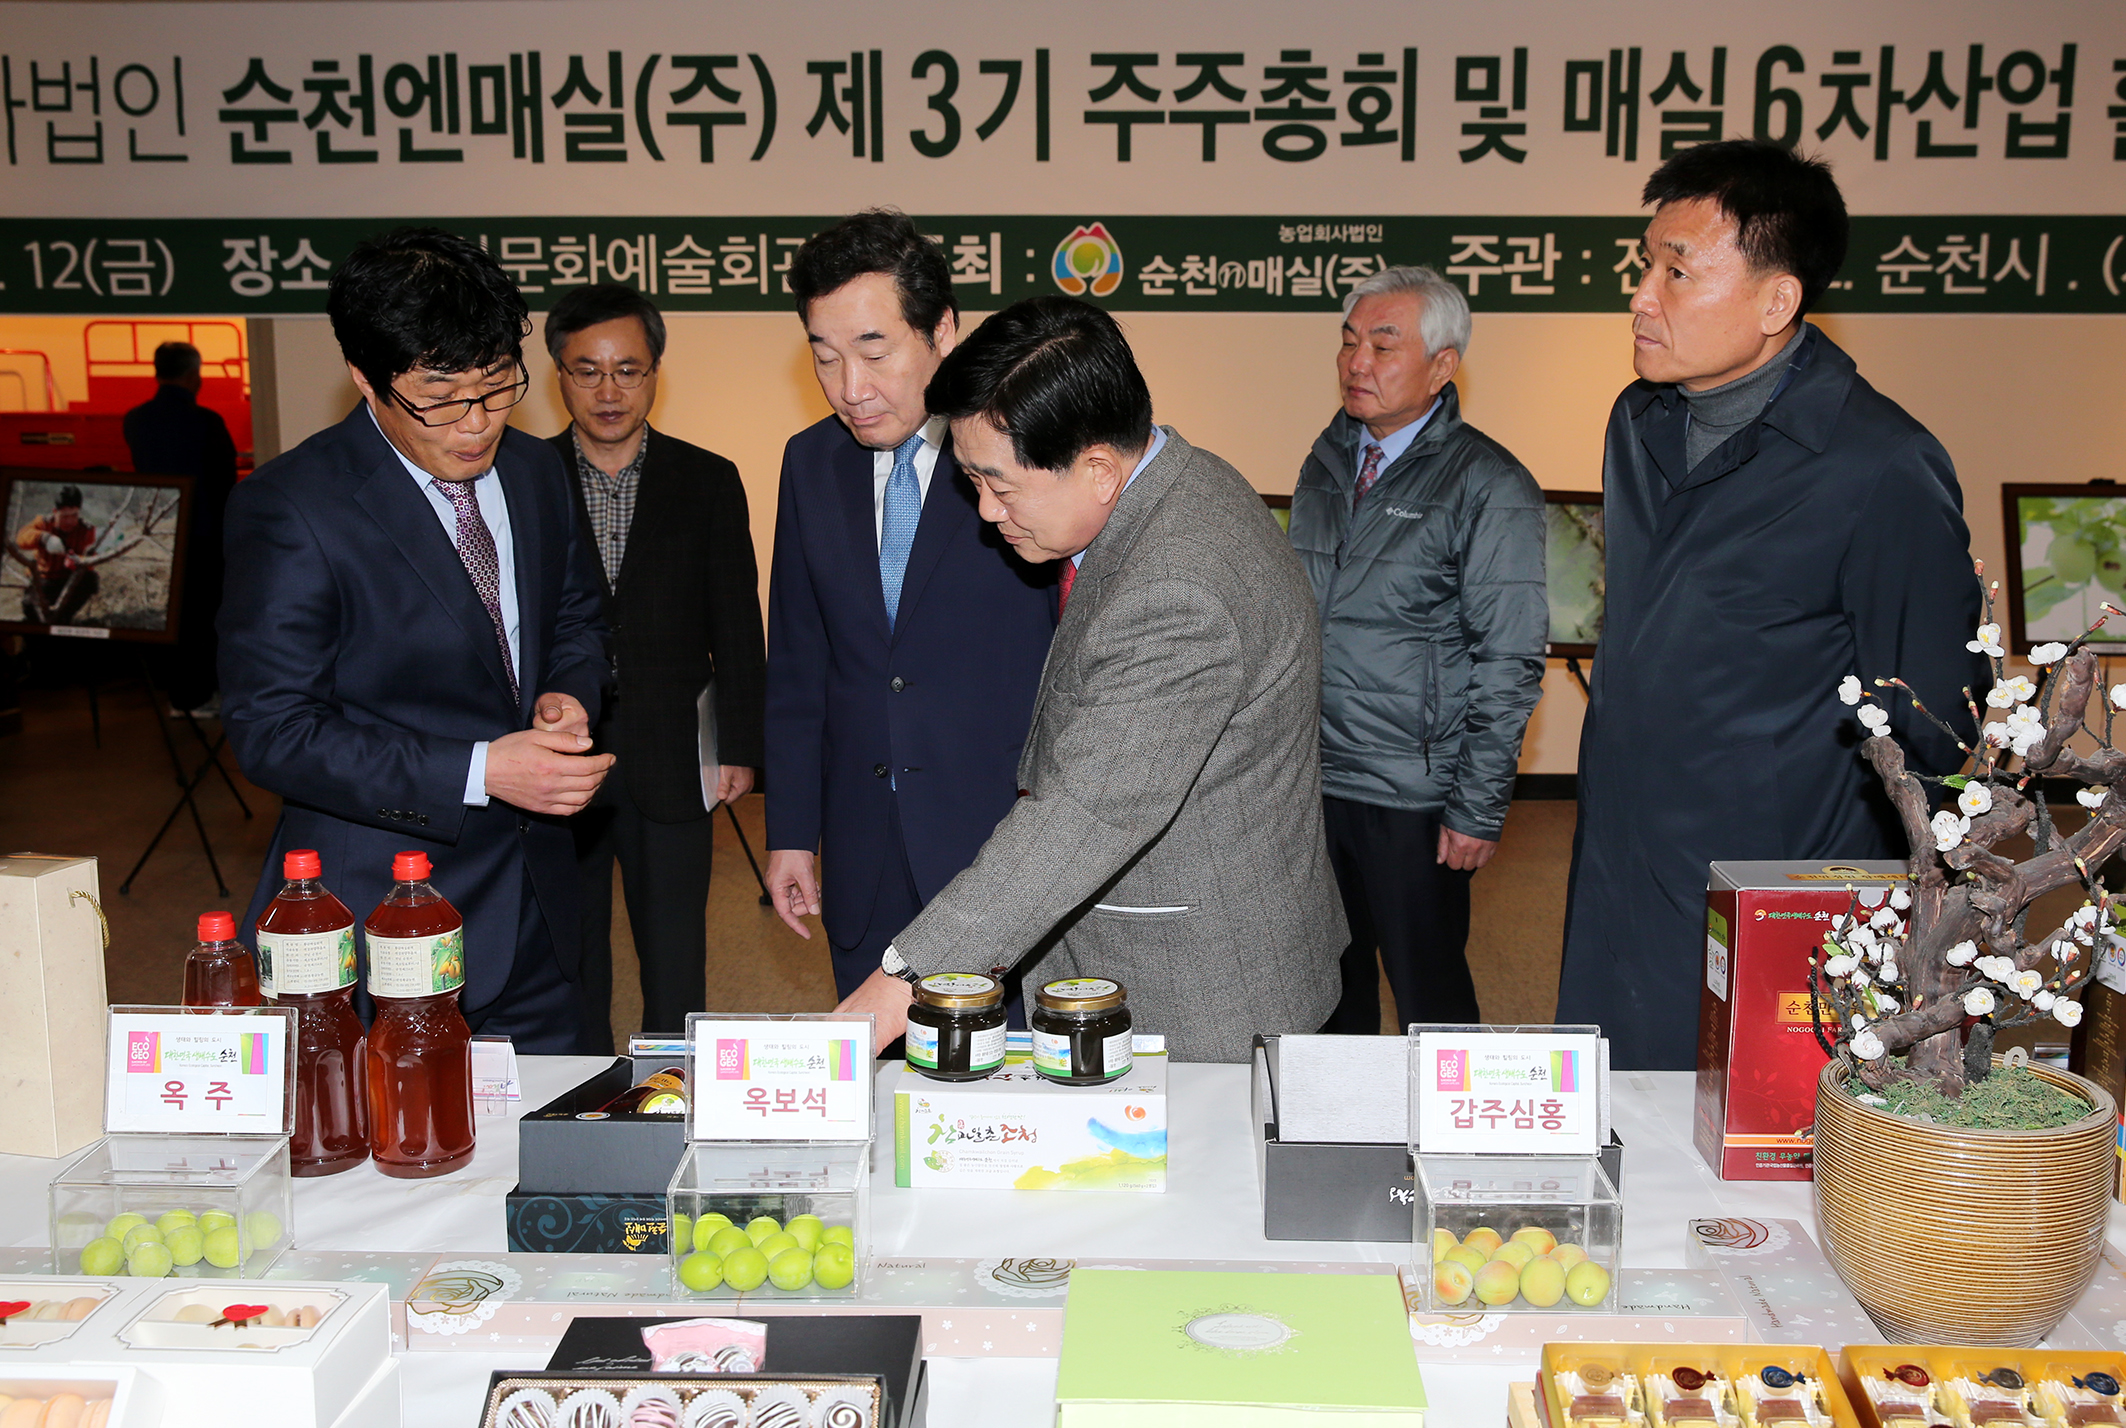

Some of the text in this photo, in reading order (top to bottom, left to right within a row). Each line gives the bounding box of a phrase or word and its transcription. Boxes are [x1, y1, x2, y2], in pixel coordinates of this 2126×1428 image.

[218, 51, 777, 165] 순천엔매실(주)
[805, 48, 885, 162] 제
[909, 48, 1050, 162] 3기
[1083, 47, 1418, 163] 주주총회
[1454, 47, 1528, 165] 및
[1563, 47, 1727, 162] 매실
[1753, 43, 2077, 162] 6차산업
[1279, 224, 1384, 243] 농업회사법인
[24, 237, 175, 297] 12(금)
[222, 235, 332, 297] 장소
[1446, 235, 1561, 297] 주관
[1876, 233, 2050, 297] 순천시
[131, 1051, 150, 1060] GEO
[219, 1048, 238, 1063] 순천
[720, 1058, 738, 1067] GEO
[807, 1055, 826, 1069] 순천
[1440, 1068, 1458, 1078] GEO
[1528, 1066, 1548, 1081] 순천
[743, 1087, 826, 1118] 옥보석
[1450, 1098, 1566, 1130] 갑주심홍
[1620, 1303, 1691, 1312] Handmade
